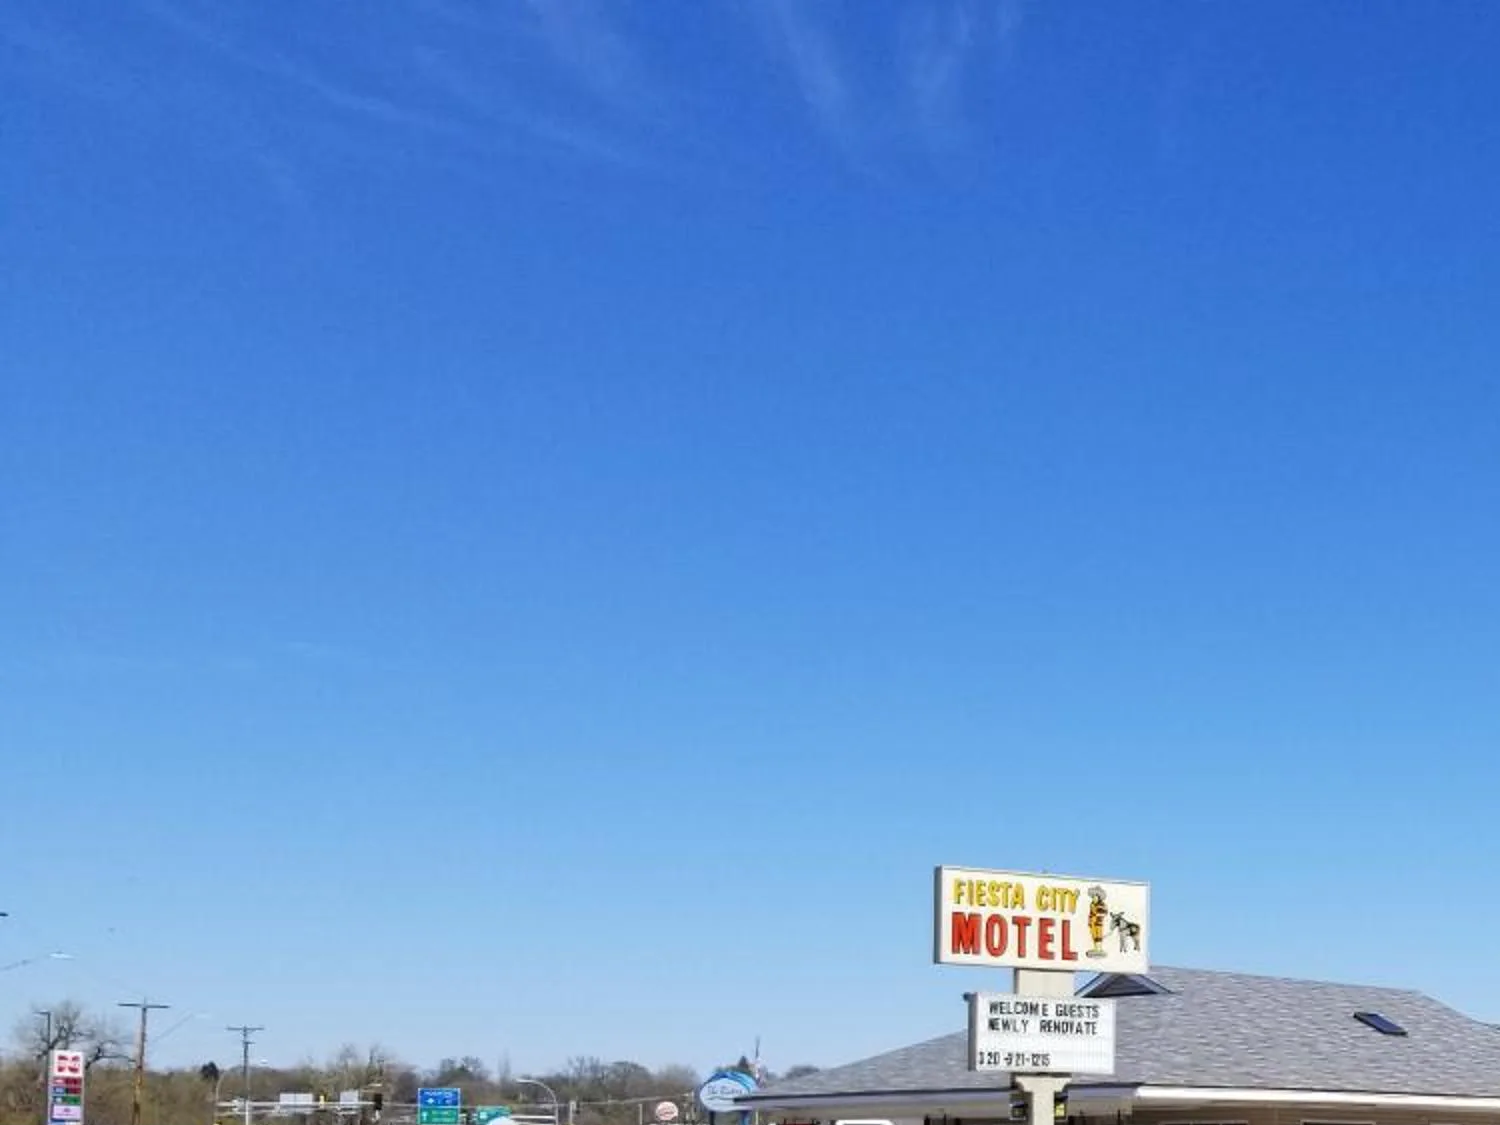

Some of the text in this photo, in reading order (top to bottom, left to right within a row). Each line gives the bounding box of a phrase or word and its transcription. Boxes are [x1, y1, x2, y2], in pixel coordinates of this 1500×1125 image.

[953, 878, 1081, 914] FIESTA CITY
[951, 911, 1079, 961] MOTEL
[989, 1001, 1100, 1018] WELCOME GUESTS
[987, 1017, 1098, 1035] NEWLY RENOVATE
